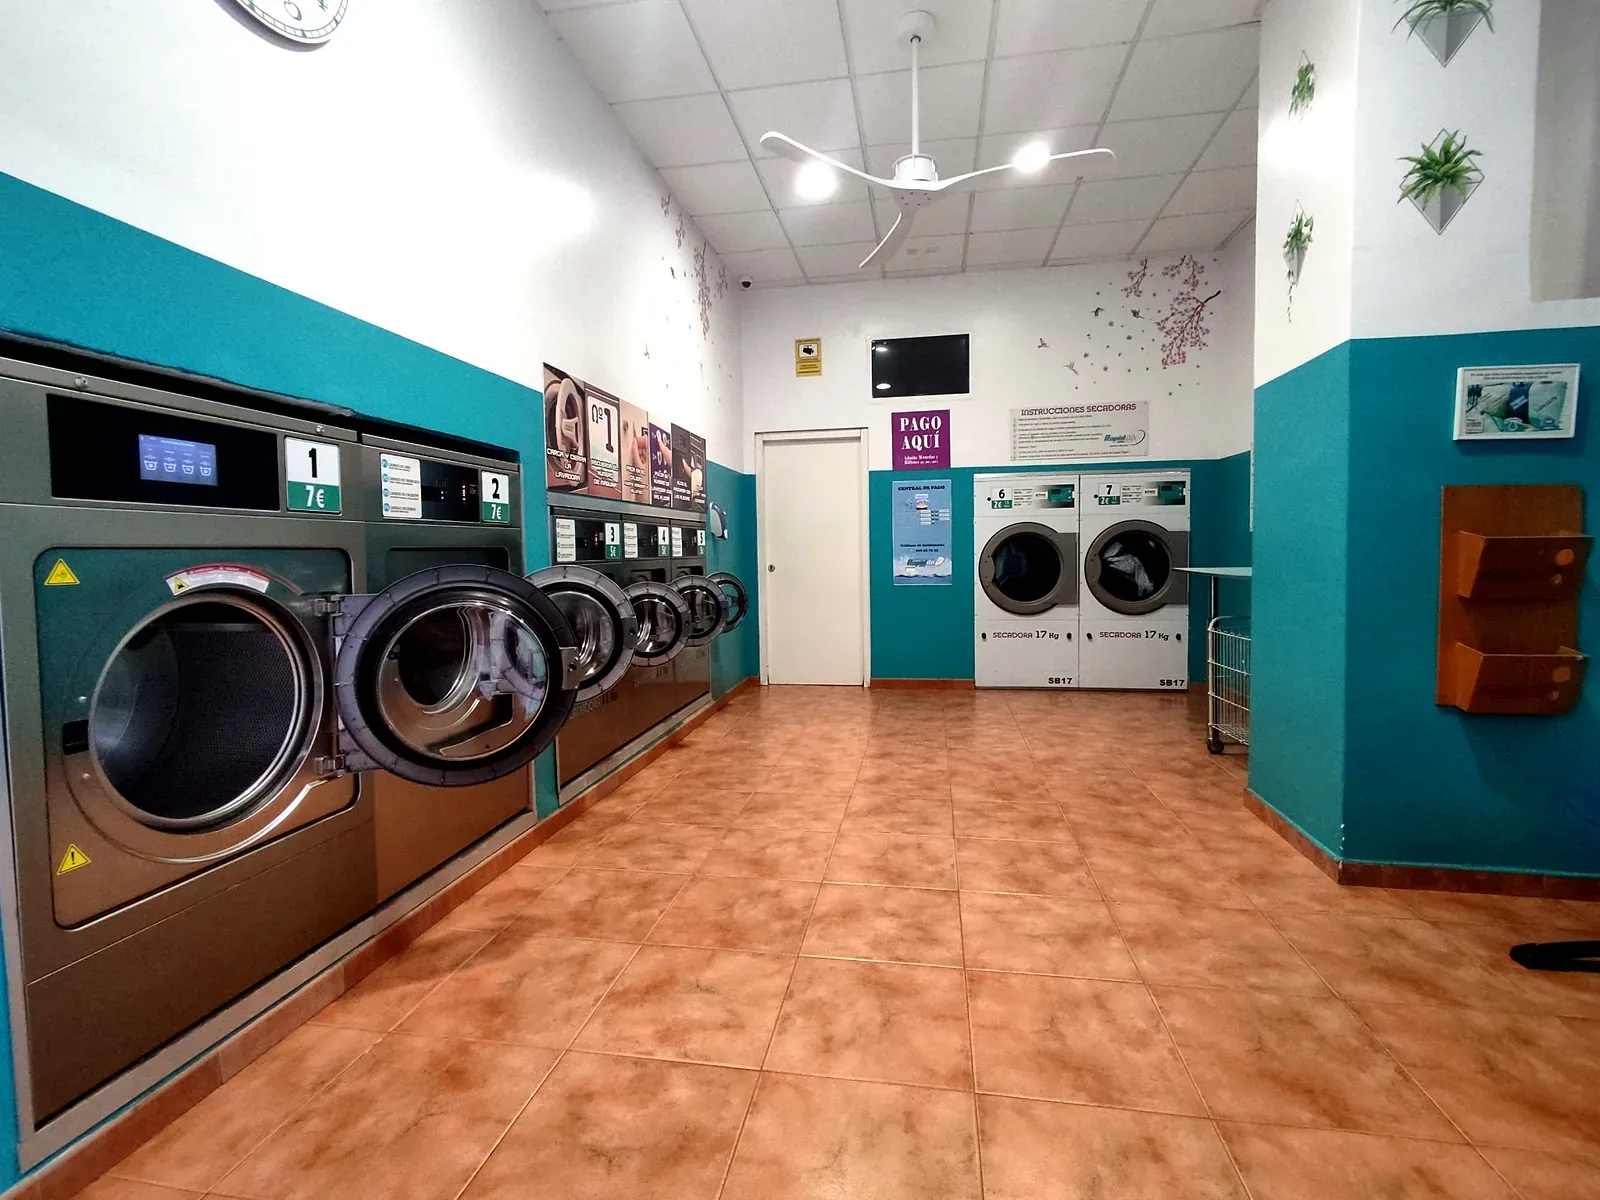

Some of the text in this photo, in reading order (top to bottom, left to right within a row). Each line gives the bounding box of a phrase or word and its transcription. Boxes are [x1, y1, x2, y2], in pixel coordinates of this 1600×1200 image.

[1021, 403, 1137, 416] INSTRUCCIONES SECADORAS
[900, 416, 942, 431] PAGO
[901, 430, 940, 451] AQUÍ
[308, 447, 318, 478] 1
[491, 477, 501, 500] 2
[998, 489, 1006, 499] 6
[1106, 485, 1113, 495] 7
[305, 485, 325, 508] 7€
[491, 504, 503, 519] 7€
[610, 526, 615, 543] 3
[992, 631, 1060, 640] SECADORA 17 Kg
[1099, 630, 1170, 641] SECADORA 17 Kg
[1048, 677, 1073, 685] SB17
